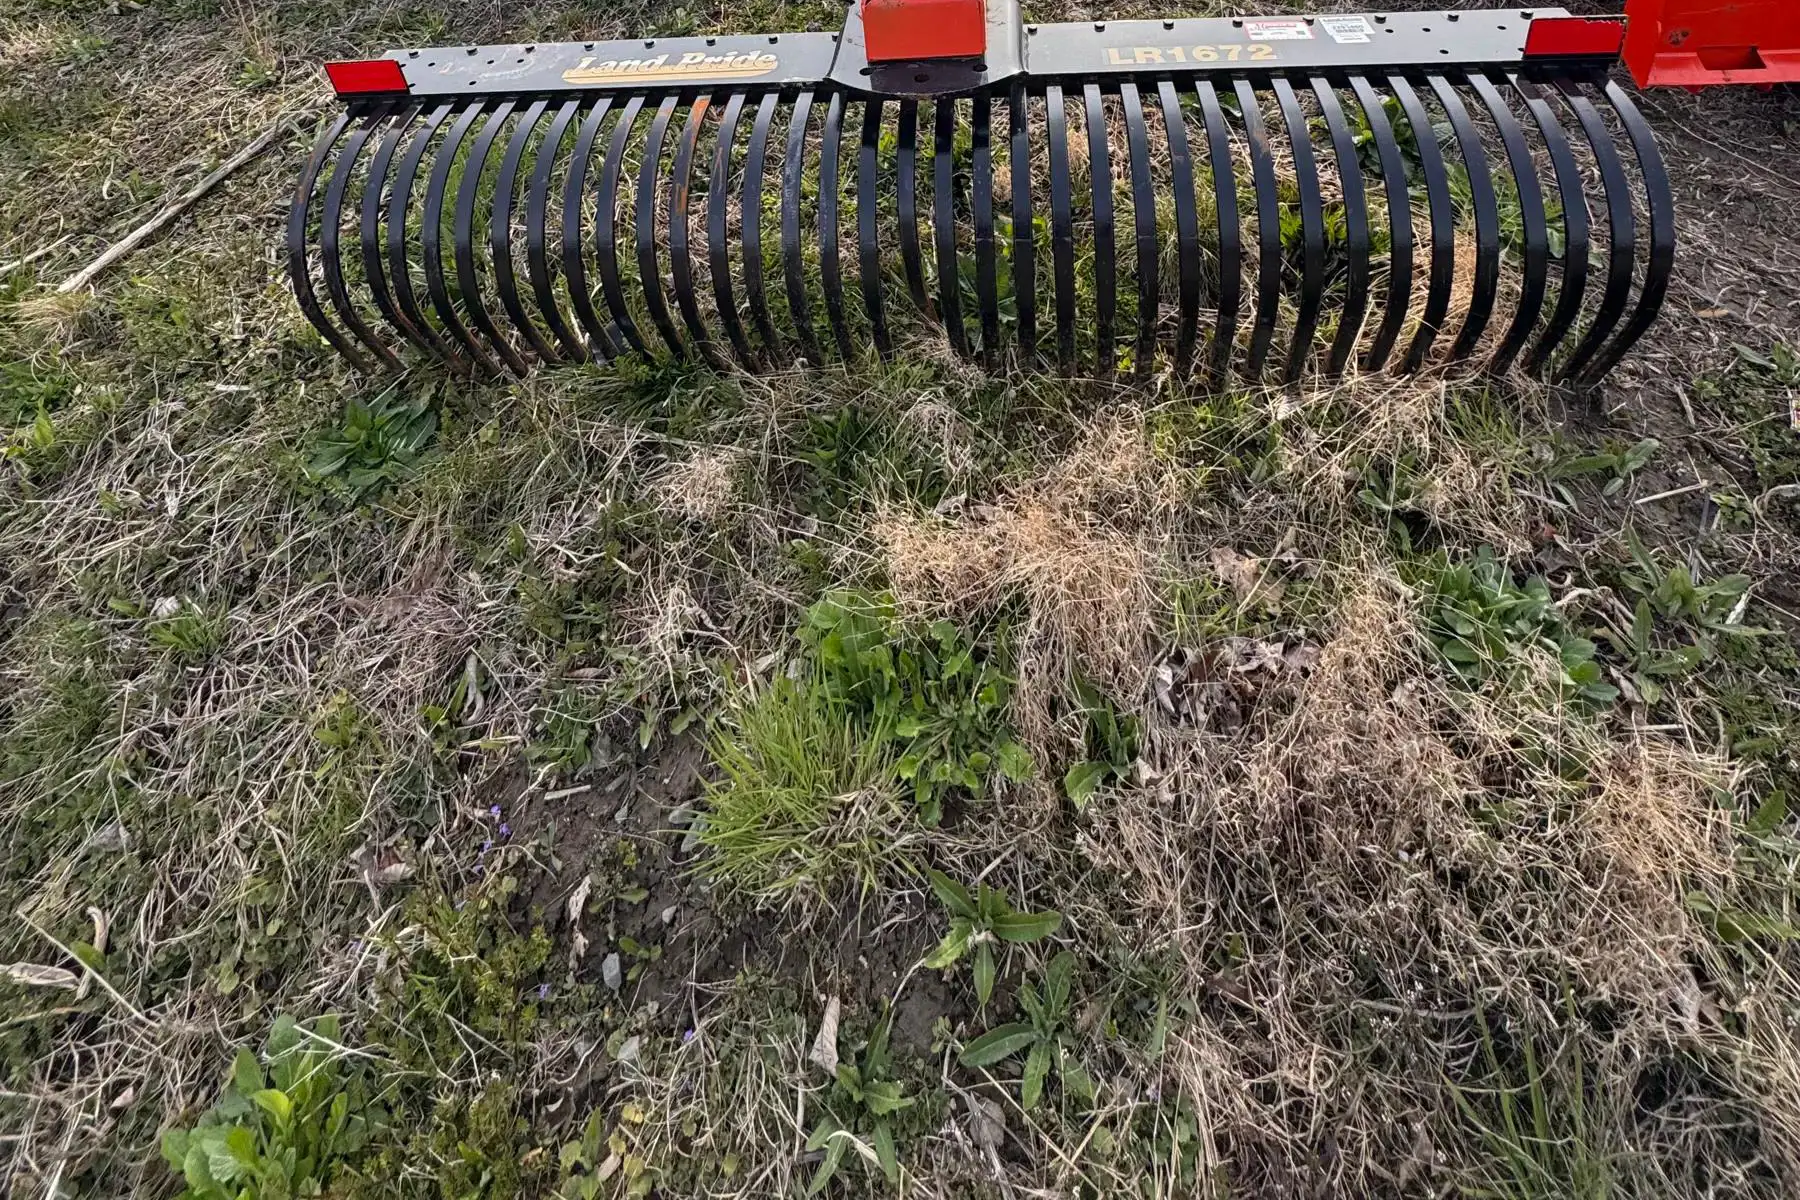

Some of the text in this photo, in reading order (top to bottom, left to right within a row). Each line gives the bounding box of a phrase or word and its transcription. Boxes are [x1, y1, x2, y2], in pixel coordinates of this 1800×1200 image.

[574, 50, 778, 75] Land Pride
[1107, 44, 1278, 65] LR1672
